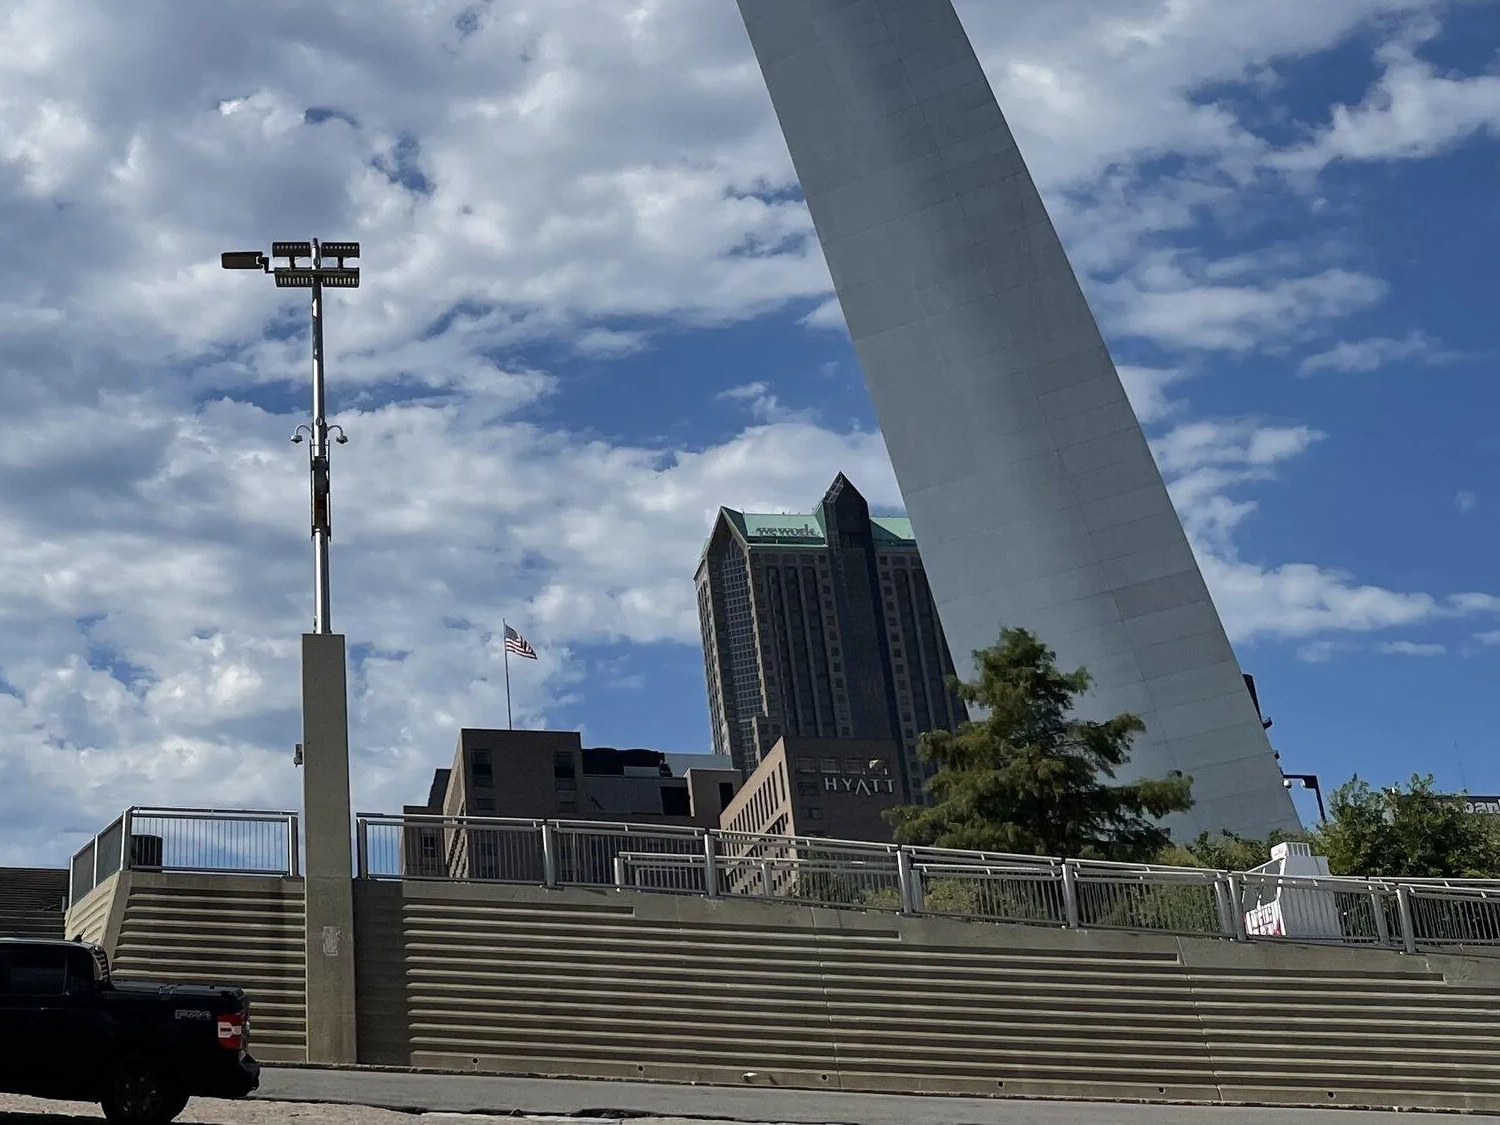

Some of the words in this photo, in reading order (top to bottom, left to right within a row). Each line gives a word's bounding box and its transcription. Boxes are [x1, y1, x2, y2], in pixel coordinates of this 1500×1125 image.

[824, 777, 895, 796] HYATT
[1462, 798, 1500, 815] ban
[175, 1009, 212, 1021] FX4
